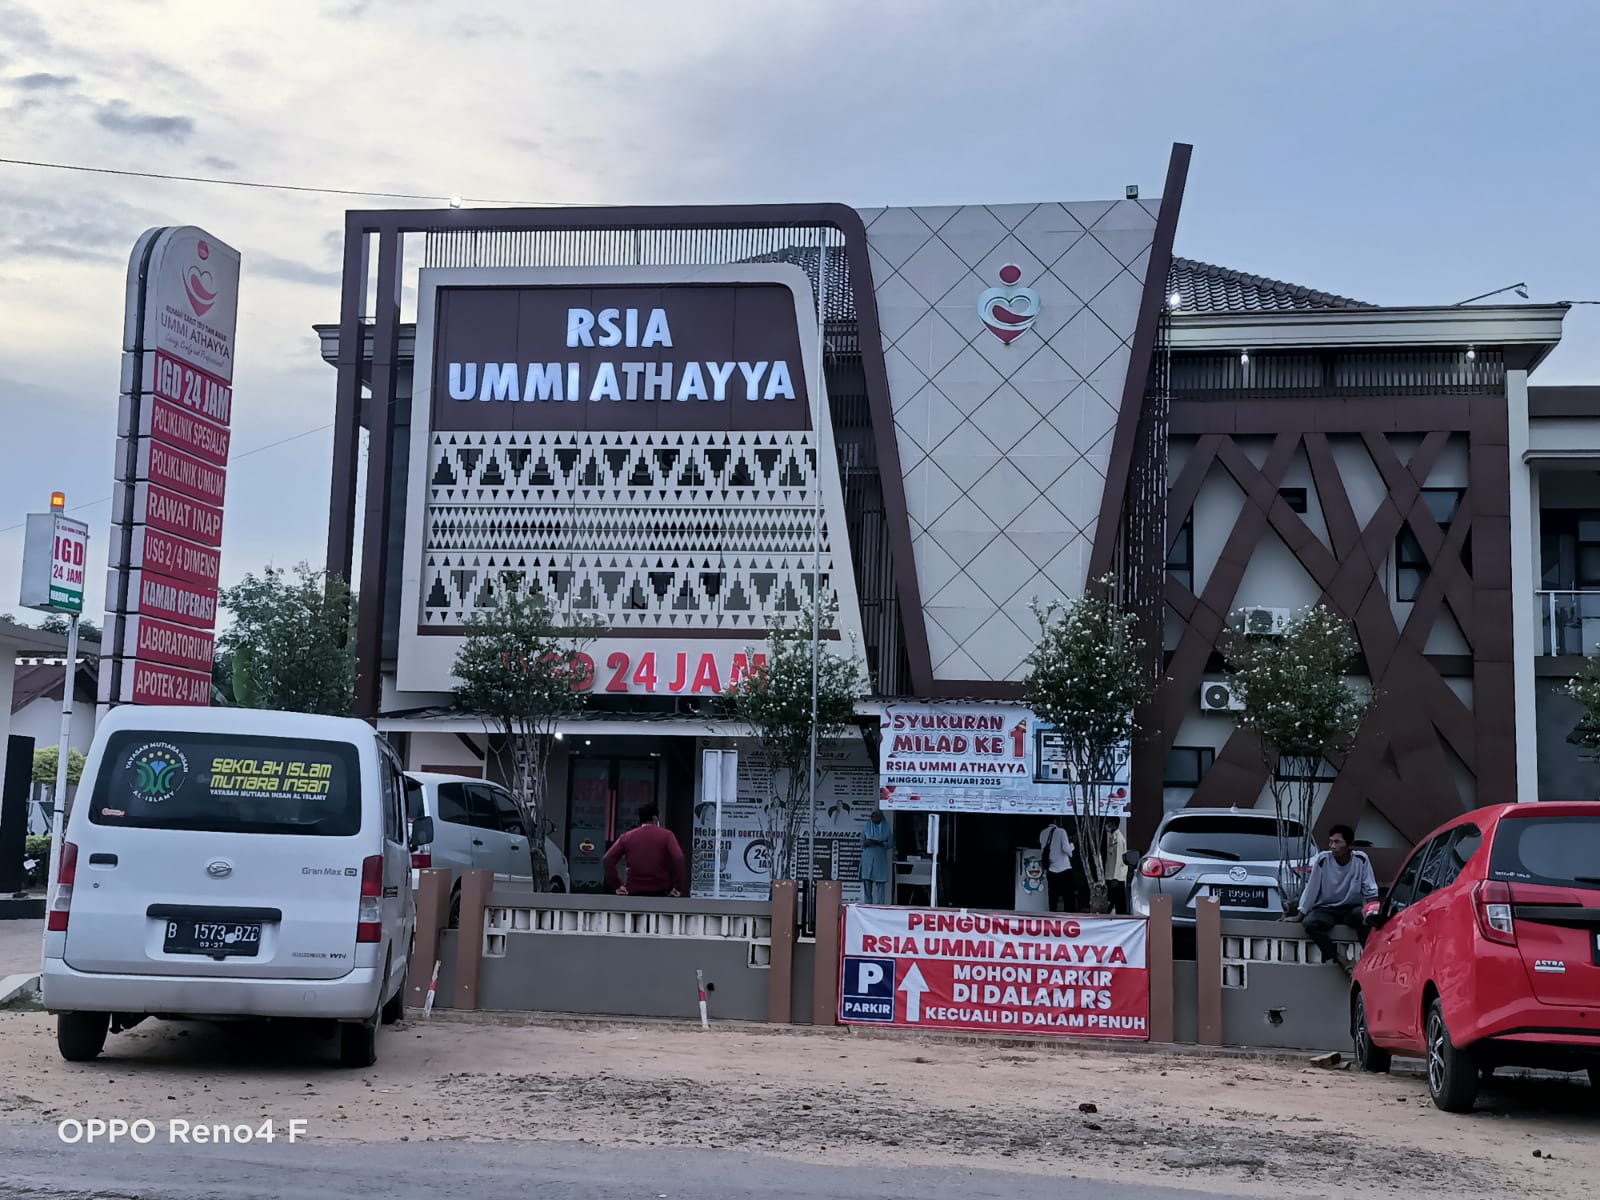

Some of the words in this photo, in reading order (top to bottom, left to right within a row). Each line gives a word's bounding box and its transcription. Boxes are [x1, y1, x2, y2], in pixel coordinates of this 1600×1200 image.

[161, 312, 188, 338] UMMI
[190, 329, 230, 360] ATHAYYA
[566, 308, 673, 348] RSIA
[157, 356, 182, 400] IGD
[184, 371, 202, 410] 24
[203, 379, 230, 422] JAM
[449, 362, 580, 402] UMMI
[589, 360, 796, 402] ATHAYYA
[154, 406, 193, 443] POLIKLINIK
[193, 423, 227, 456] SPESIALIS
[152, 448, 197, 487] POLIKLINIK
[198, 466, 224, 497] UMUM
[149, 492, 191, 528] RAWAT
[193, 507, 221, 537] INAP
[54, 536, 83, 566] IGD
[146, 536, 165, 564] USG
[166, 542, 182, 572] 2/4
[184, 548, 219, 579] DIMENSI
[53, 564, 64, 579] 24
[66, 568, 82, 585] JAM
[143, 580, 177, 612] KAMAR
[178, 590, 215, 621] OPERASI
[140, 625, 212, 662] LABORATORIUM
[136, 670, 175, 698] APOTEK
[176, 677, 188, 701] 24
[189, 678, 209, 703] JAM
[605, 652, 658, 692] 24
[894, 714, 1004, 730] SYUKURAN
[892, 735, 968, 754] MILAD
[974, 735, 1004, 754] KE
[1009, 726, 1025, 758] 1
[886, 761, 916, 771] RSIA
[919, 762, 957, 772] UMMI
[959, 763, 1026, 774] ATHAYYA
[887, 777, 926, 785] MINGGU,
[979, 778, 1001, 786] 2025
[240, 790, 270, 798] MUTIARA
[302, 867, 323, 876] Gran
[324, 868, 342, 876] Max
[167, 922, 178, 938] B
[194, 924, 226, 940] 1573
[908, 913, 1081, 938] PENGUNJUNG
[862, 934, 919, 955] RSIA
[924, 937, 995, 959] UMMI
[999, 941, 1128, 965] ATHAYYA
[1535, 960, 1565, 968] ASTRA
[857, 962, 884, 994] P
[952, 964, 1032, 984] MOHON
[1036, 968, 1113, 987] PARKIR
[844, 1002, 891, 1014] PARKIR
[952, 983, 978, 1003] DI
[983, 984, 1075, 1009] DALAM
[1080, 989, 1112, 1010] RS
[925, 1006, 998, 1023] KECUALI
[1001, 1010, 1018, 1024] DI
[1022, 1012, 1084, 1027] DALAM
[1087, 1015, 1146, 1030] PENUH
